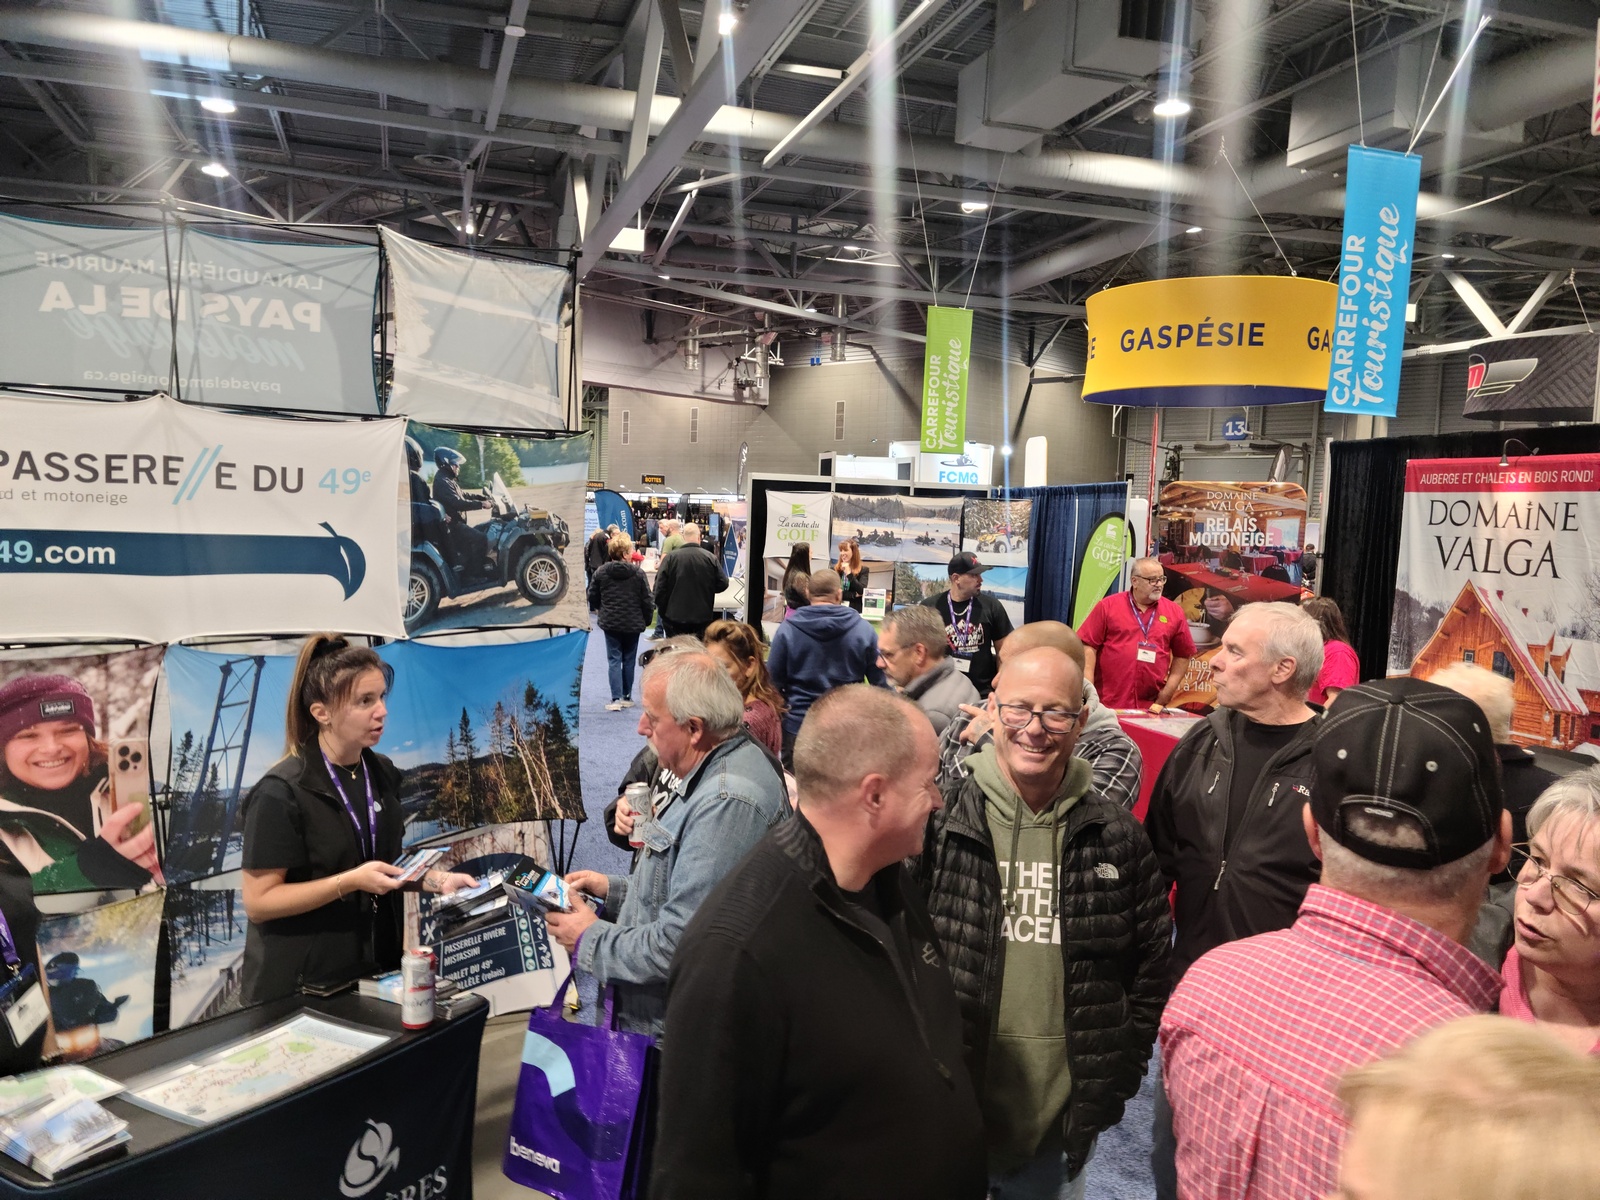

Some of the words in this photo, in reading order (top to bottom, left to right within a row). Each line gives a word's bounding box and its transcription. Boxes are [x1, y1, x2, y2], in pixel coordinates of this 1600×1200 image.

[1352, 202, 1408, 407] Touristique
[1331, 234, 1366, 406] CARREFOUR
[1120, 316, 1266, 352] GASPÉSIE
[938, 336, 967, 450] Touristique
[925, 355, 941, 449] CARREFOUR
[1225, 421, 1245, 436] 13
[253, 464, 304, 494] DU
[644, 476, 662, 484] BOTTES
[1420, 473, 1460, 485] AUBERGE
[1462, 472, 1474, 484] ET
[1475, 472, 1516, 484] CHALETS
[1518, 471, 1532, 483] EN
[1534, 470, 1558, 484] BOIS
[1560, 469, 1594, 483] ROND!
[21, 489, 37, 501] et
[44, 491, 128, 506] motoneige
[1206, 491, 1258, 501] DOMAINE
[1208, 500, 1254, 512] VALGA
[777, 516, 790, 527] La
[1206, 517, 1258, 532] RELAIS
[777, 528, 819, 541] GOLF
[1189, 531, 1274, 547] MOTONEIGE
[1434, 535, 1561, 579] VALGA
[1193, 681, 1212, 692] 14h
[444, 934, 482, 955] PASSERELLE
[482, 926, 507, 941] RIVIÈRE
[443, 946, 481, 967] MISTASSINI
[469, 963, 480, 974] DU
[510, 1135, 560, 1174] beneva
